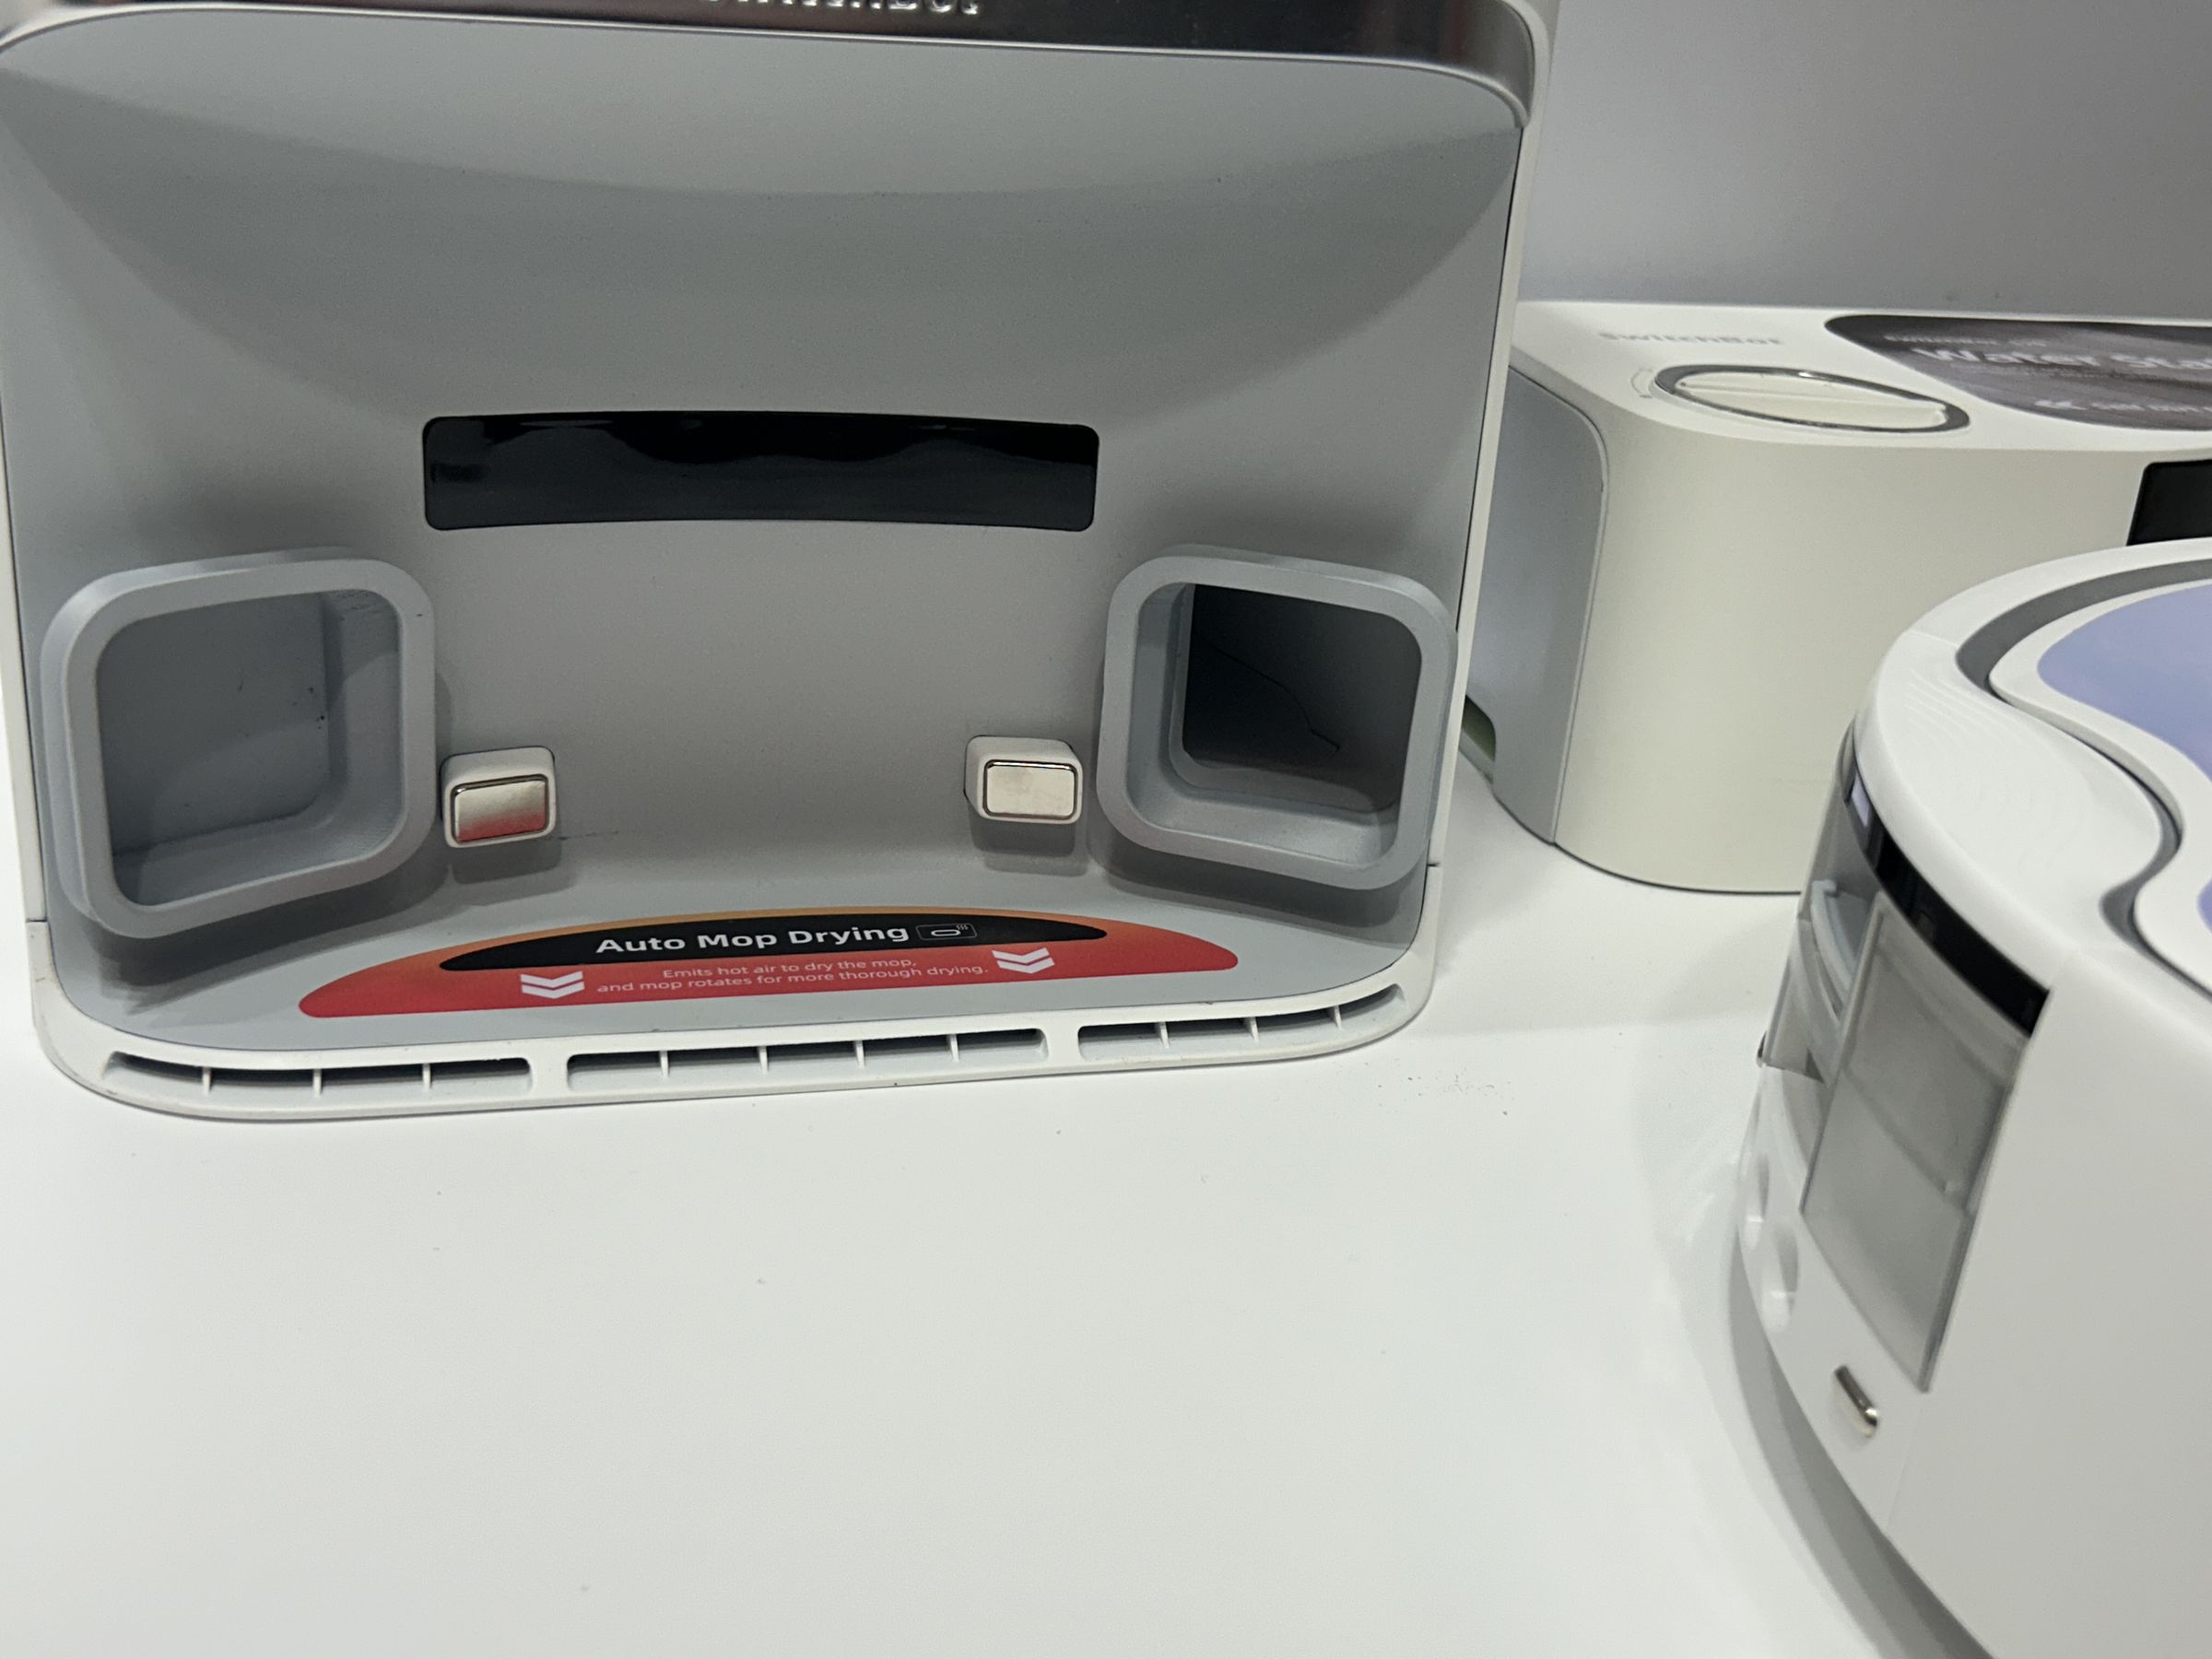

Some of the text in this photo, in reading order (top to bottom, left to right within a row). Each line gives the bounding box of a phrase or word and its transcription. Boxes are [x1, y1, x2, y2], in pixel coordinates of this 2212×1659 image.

[1598, 333, 1783, 345] SwitchBot
[1911, 347, 2212, 370] Water Sta
[595, 926, 909, 953] Auto Mop Drying
[596, 964, 989, 992] and mop rotates for more thorough drying.
[663, 958, 916, 978] Emits hot air to dry the mop,
